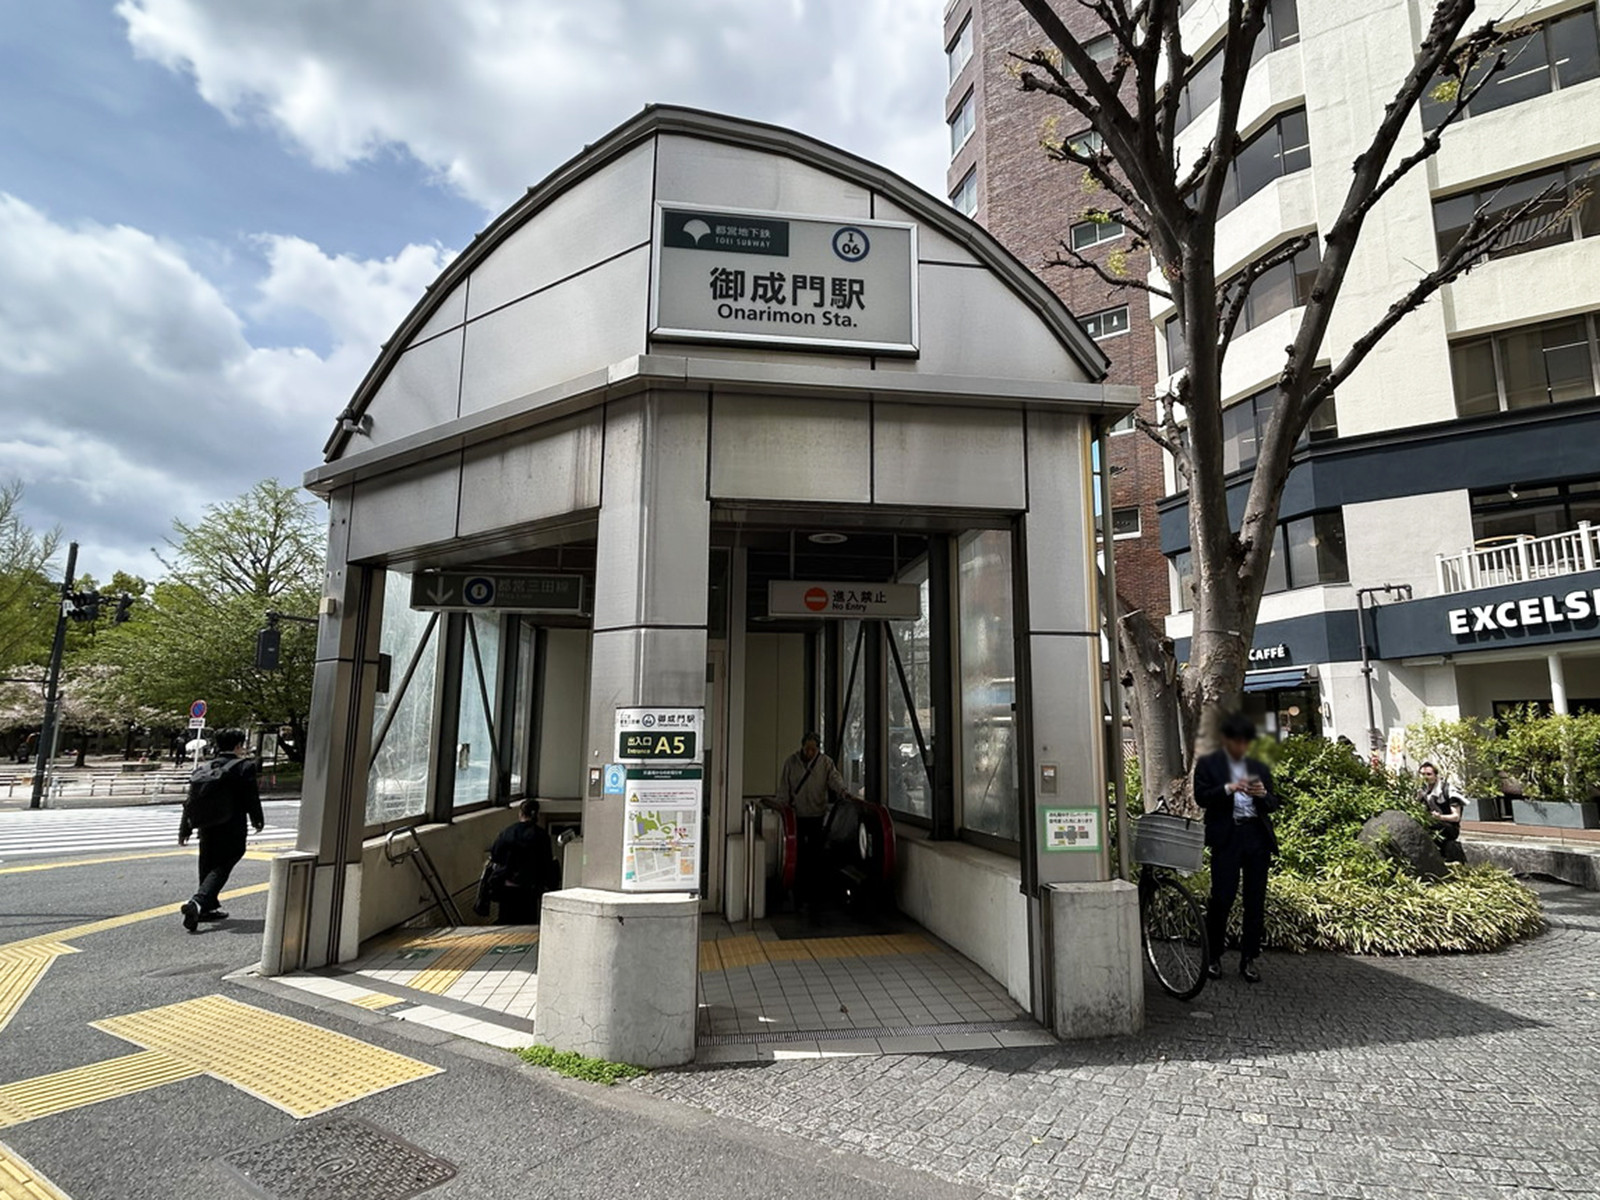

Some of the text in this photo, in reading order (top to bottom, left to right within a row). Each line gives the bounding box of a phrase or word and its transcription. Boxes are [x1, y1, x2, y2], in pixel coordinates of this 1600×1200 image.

[715, 225, 771, 239] 都営地下鉄
[848, 233, 854, 243] I
[715, 237, 771, 248] TOEI SUBWAY
[842, 243, 860, 255] 06
[710, 267, 865, 310] 御成門駅
[717, 303, 858, 328] Onarimon Sta.
[832, 590, 887, 604] 進入禁止
[832, 602, 867, 613] No Entry
[1248, 643, 1286, 661] CAFFÉ
[627, 736, 652, 746] 出入口
[654, 735, 686, 755] A5
